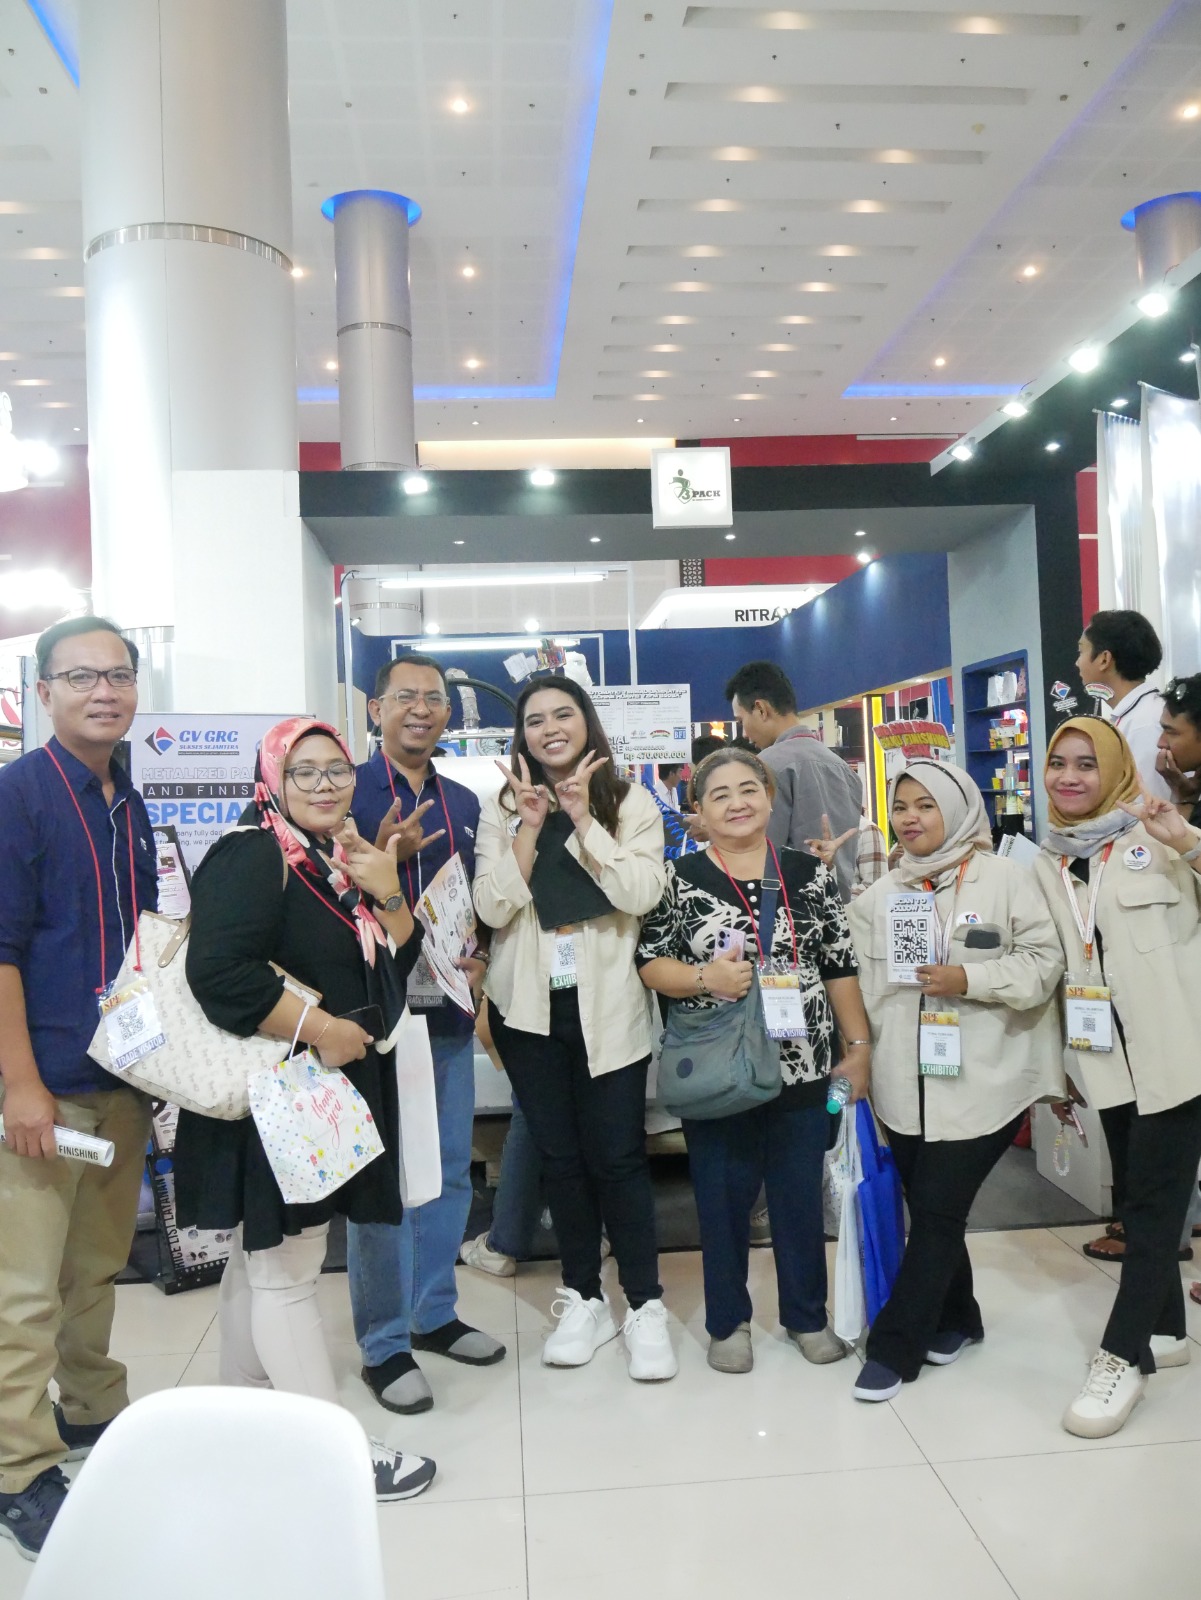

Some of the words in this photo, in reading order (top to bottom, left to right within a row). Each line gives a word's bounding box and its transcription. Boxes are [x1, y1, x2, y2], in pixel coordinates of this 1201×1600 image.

[179, 730, 202, 743] CV
[204, 730, 239, 743] GRC
[142, 767, 228, 780] METALIZED
[148, 786, 184, 796] AND
[117, 1048, 139, 1067] TRADE
[139, 1034, 164, 1056] VISITOR
[922, 1064, 959, 1076] EXHIBITOR
[58, 1144, 99, 1161] FINISHING
